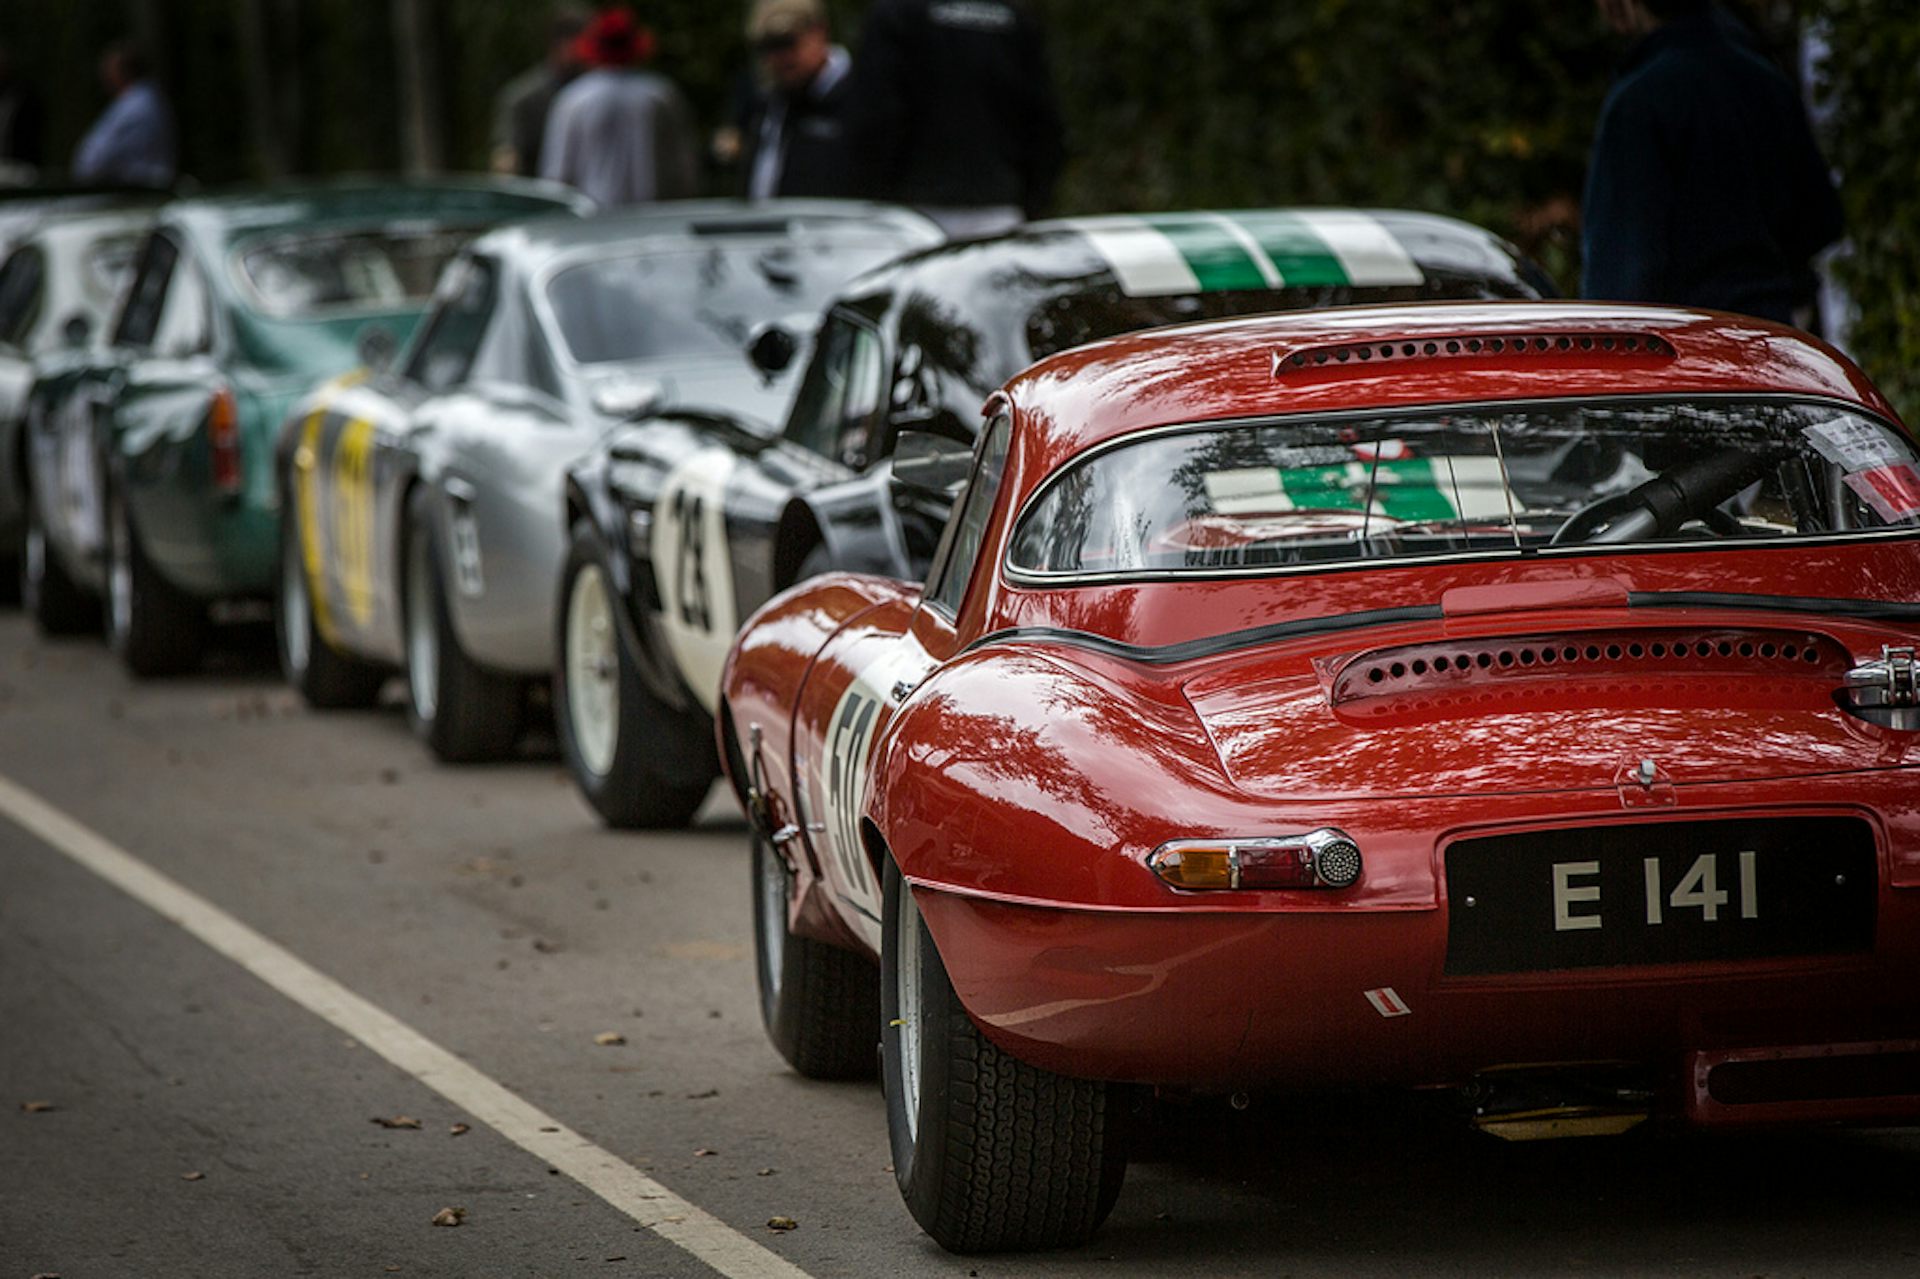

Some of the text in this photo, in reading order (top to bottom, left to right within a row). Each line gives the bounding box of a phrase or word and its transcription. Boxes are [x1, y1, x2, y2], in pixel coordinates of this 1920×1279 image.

[831, 692, 877, 894] 50
[1552, 851, 1758, 931] E 141
